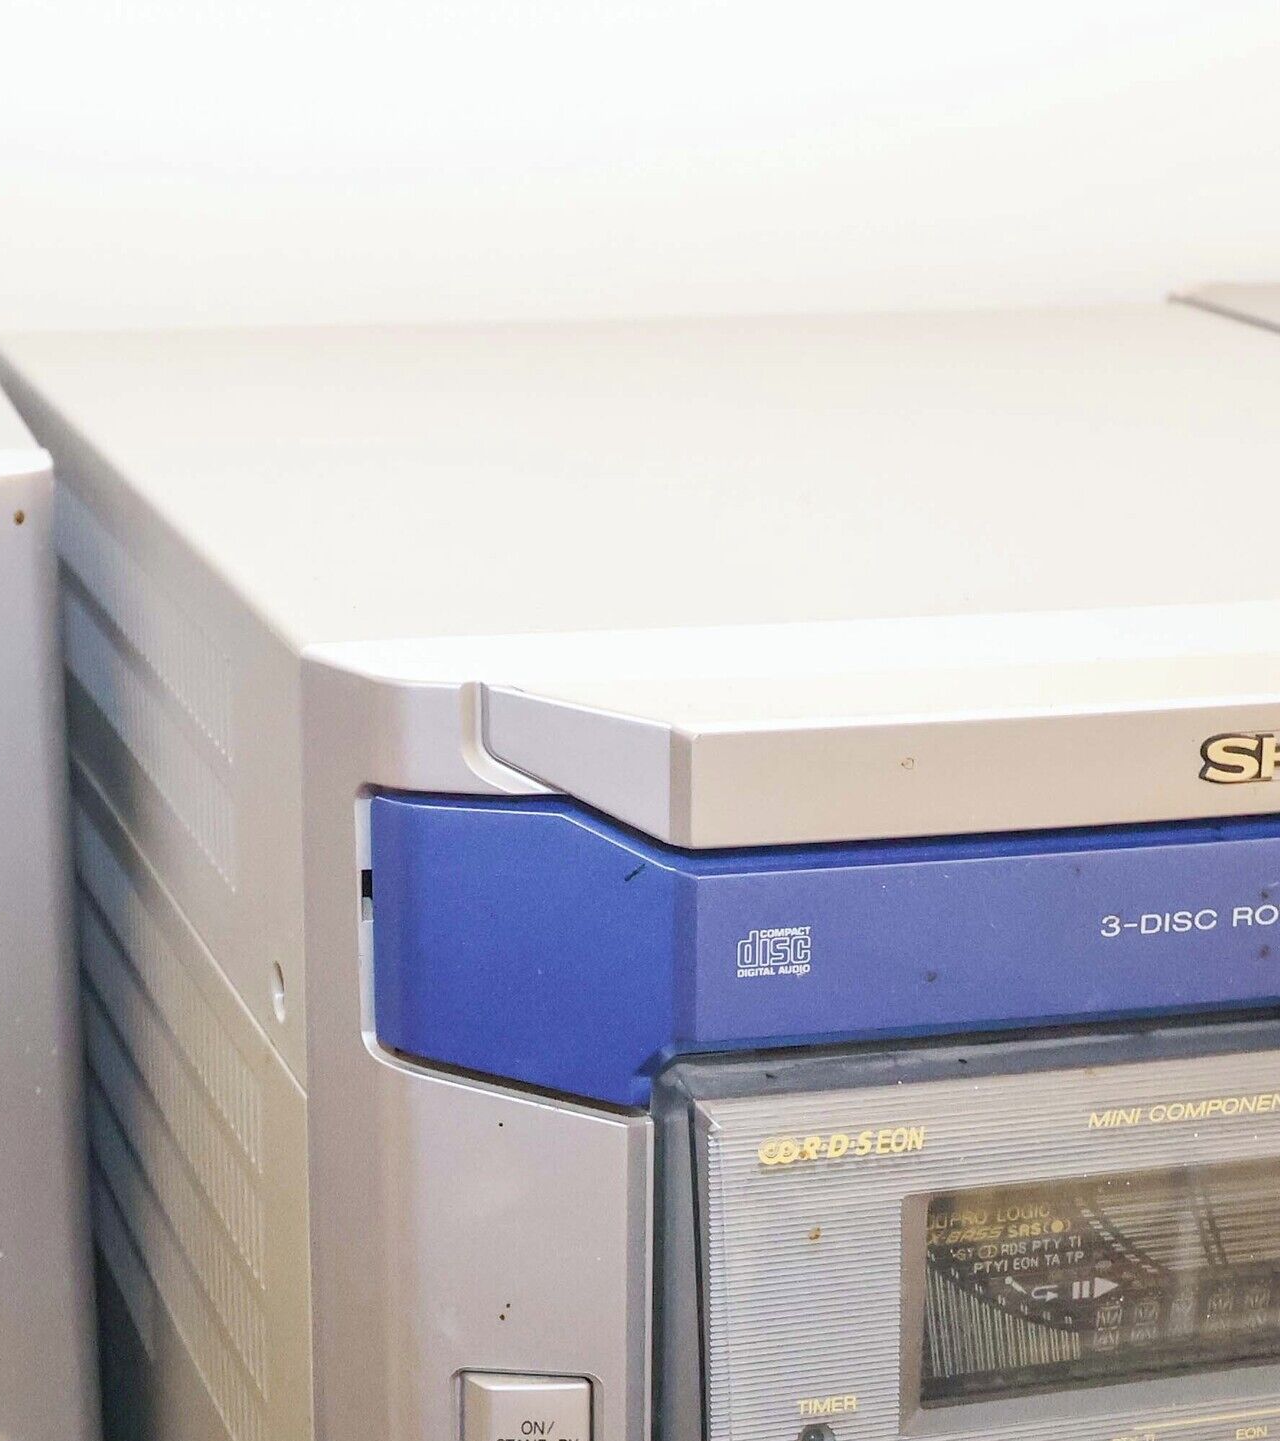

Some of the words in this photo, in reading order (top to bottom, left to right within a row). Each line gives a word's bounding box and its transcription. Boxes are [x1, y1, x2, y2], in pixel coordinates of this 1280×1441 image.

[760, 926, 811, 938] COMPACT
[1100, 909, 1218, 937] 3-DISC
[737, 930, 811, 969] disc
[737, 967, 776, 978] DIGITAL
[778, 964, 811, 976] AUDIO
[1088, 1108, 1142, 1129] MINI
[876, 1126, 925, 1154] EON
[1031, 1237, 1062, 1253] PTY
[1013, 1254, 1039, 1271] EON
[1044, 1252, 1060, 1266] TA
[1066, 1250, 1084, 1263] TP
[797, 1395, 857, 1414] TIMER
[520, 1420, 555, 1435] ON/
[1235, 1425, 1269, 1441] EON
